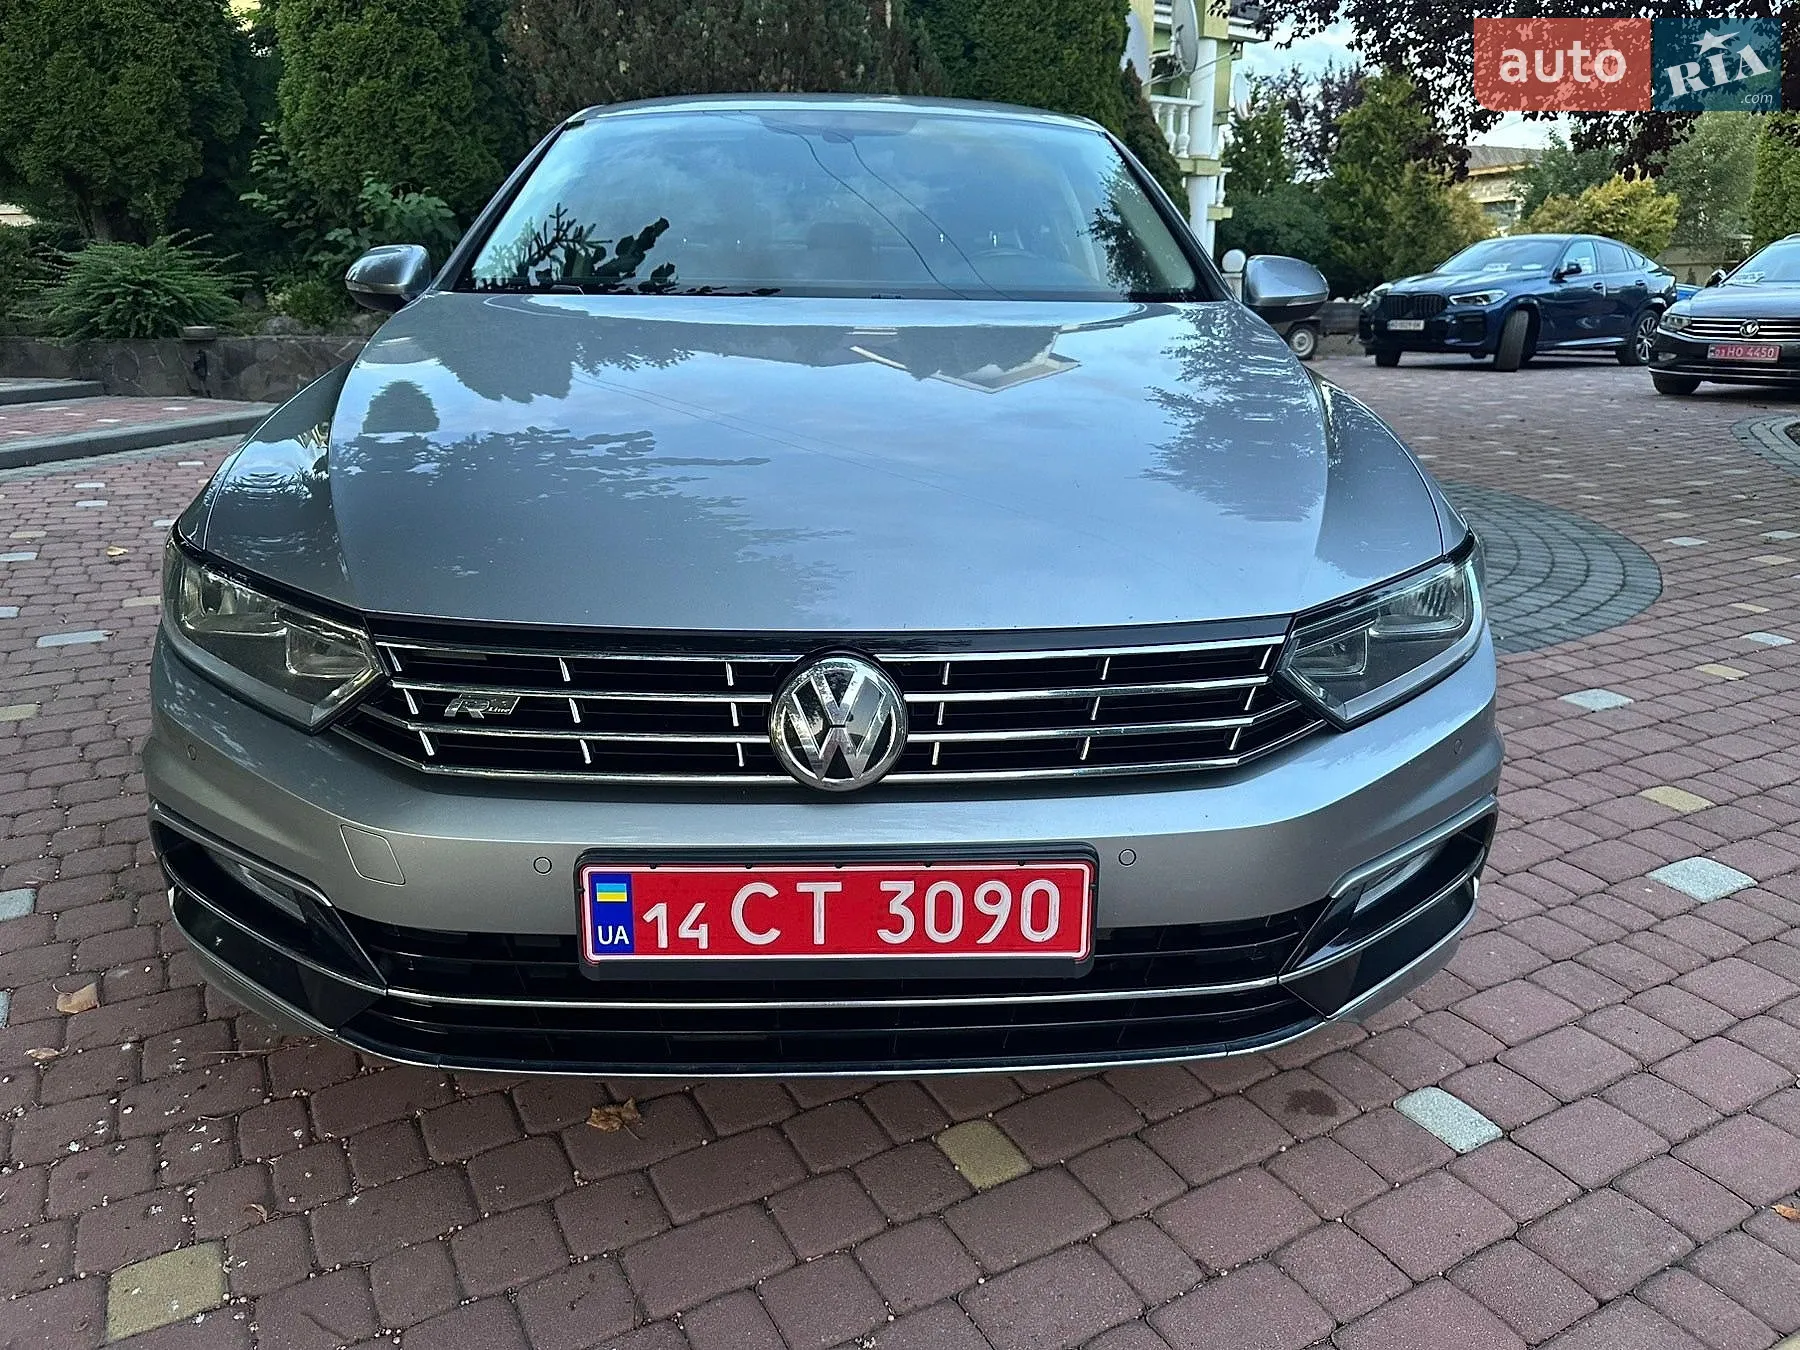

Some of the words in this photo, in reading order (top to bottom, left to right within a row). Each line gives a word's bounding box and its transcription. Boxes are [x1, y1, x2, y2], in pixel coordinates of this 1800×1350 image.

[1746, 346, 1775, 358] 4450
[642, 902, 709, 950] 14
[730, 881, 843, 946] CT
[876, 879, 1061, 945] 3090
[597, 925, 630, 946] UA
